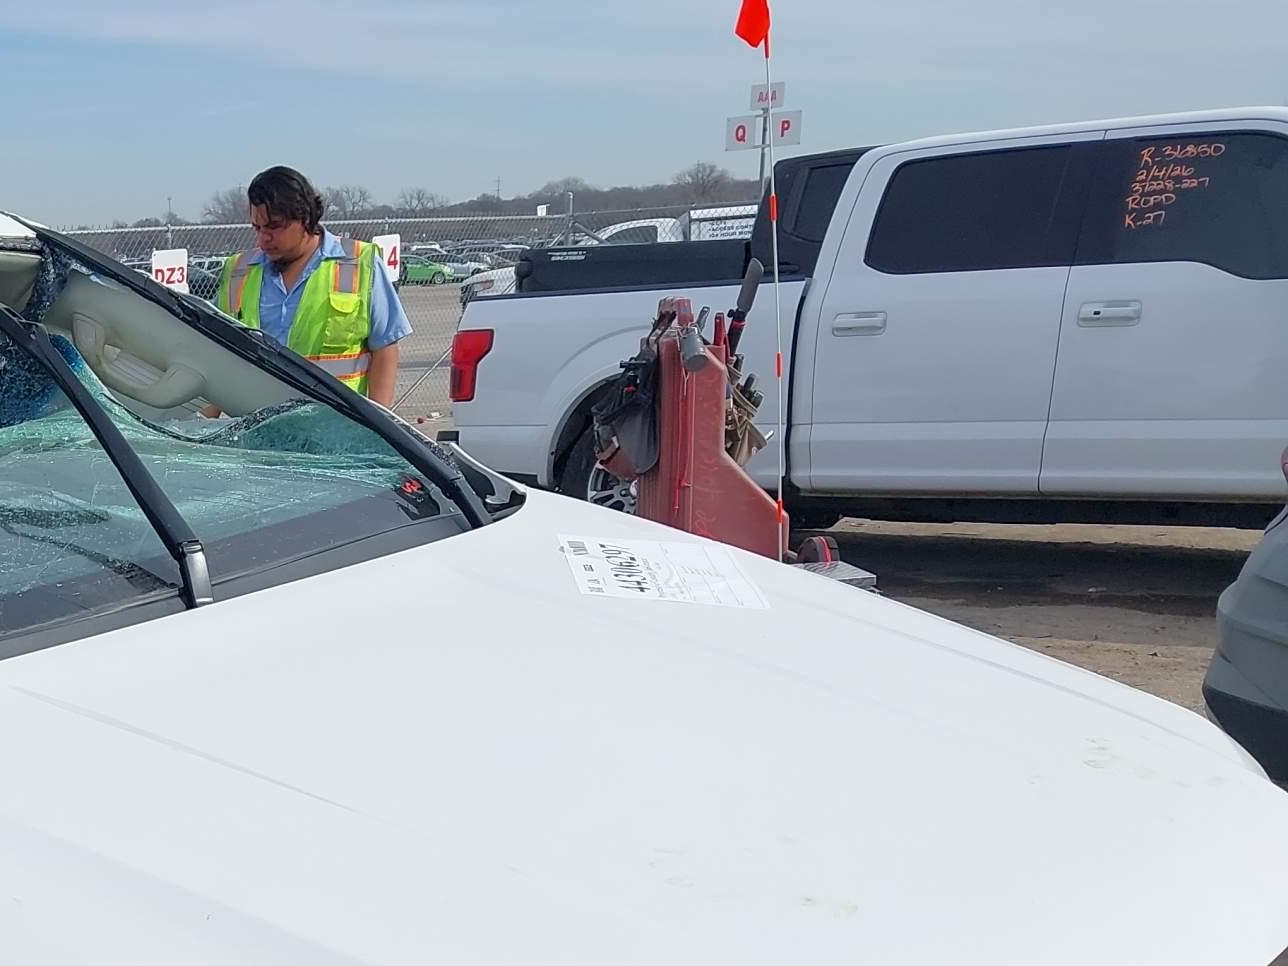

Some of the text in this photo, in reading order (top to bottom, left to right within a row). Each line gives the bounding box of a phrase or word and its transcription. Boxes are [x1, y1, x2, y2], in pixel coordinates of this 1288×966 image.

[735, 124, 746, 143] Q
[780, 119, 791, 138] P
[1136, 164, 1194, 182] 2/4/26
[1124, 210, 1165, 229] K-27
[387, 246, 398, 270] 4
[155, 266, 185, 285] DZ3
[599, 543, 651, 593] 44306297
